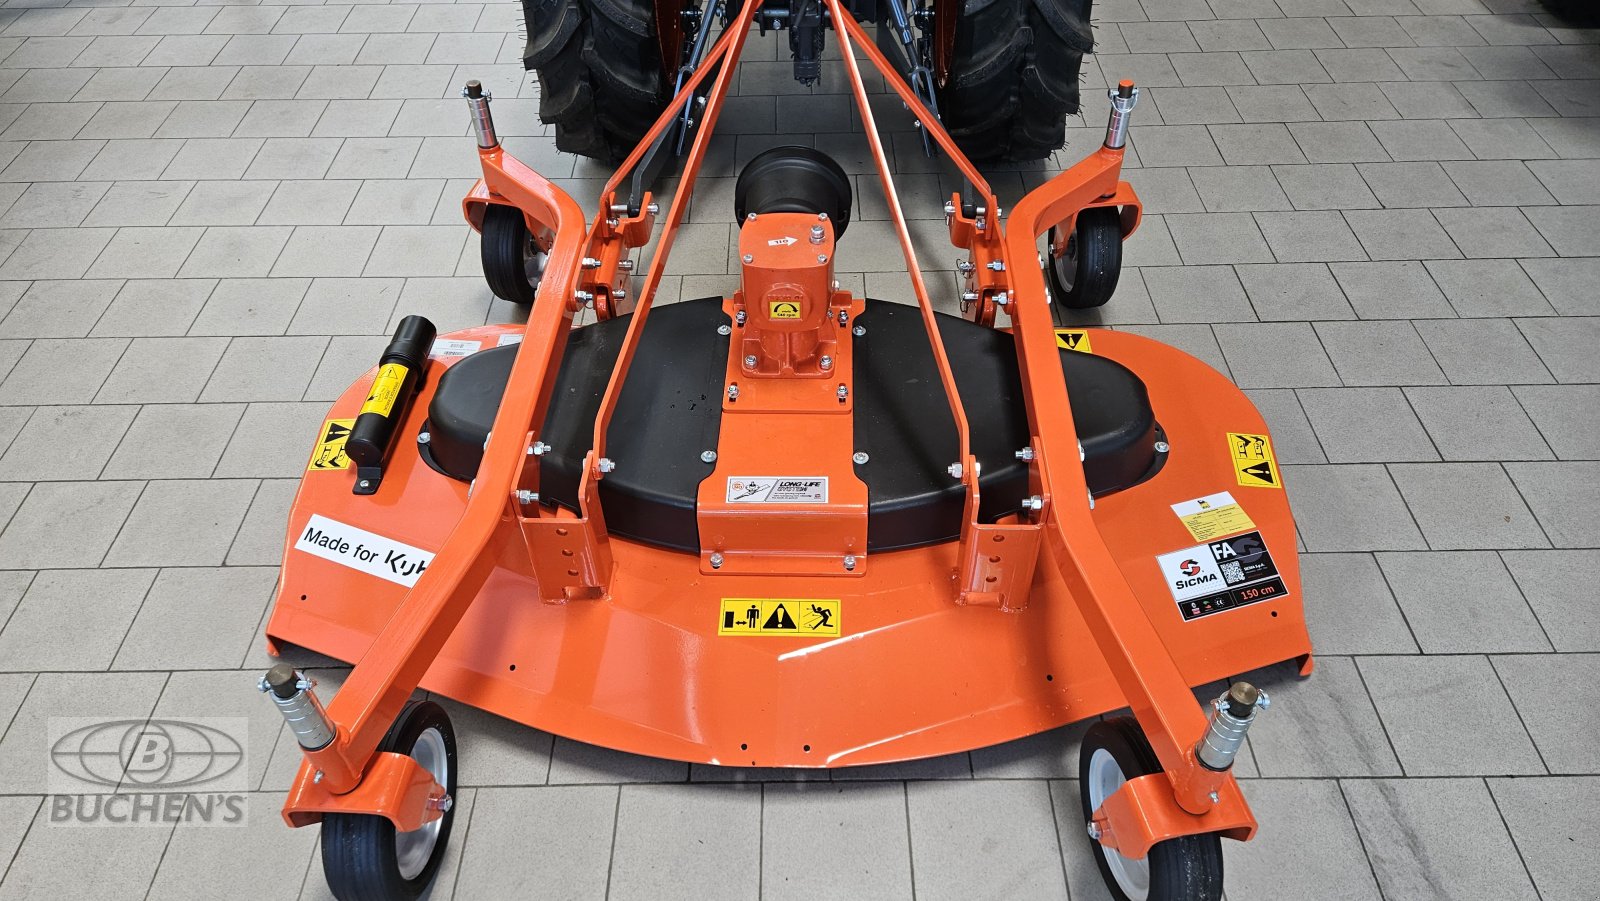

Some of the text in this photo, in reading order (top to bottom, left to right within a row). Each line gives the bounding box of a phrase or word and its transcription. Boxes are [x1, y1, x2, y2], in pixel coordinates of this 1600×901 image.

[303, 527, 350, 554] Made
[353, 544, 379, 563] for
[1211, 541, 1237, 560] FA
[1175, 573, 1217, 590] SICMA
[1241, 586, 1275, 600] 150 cm
